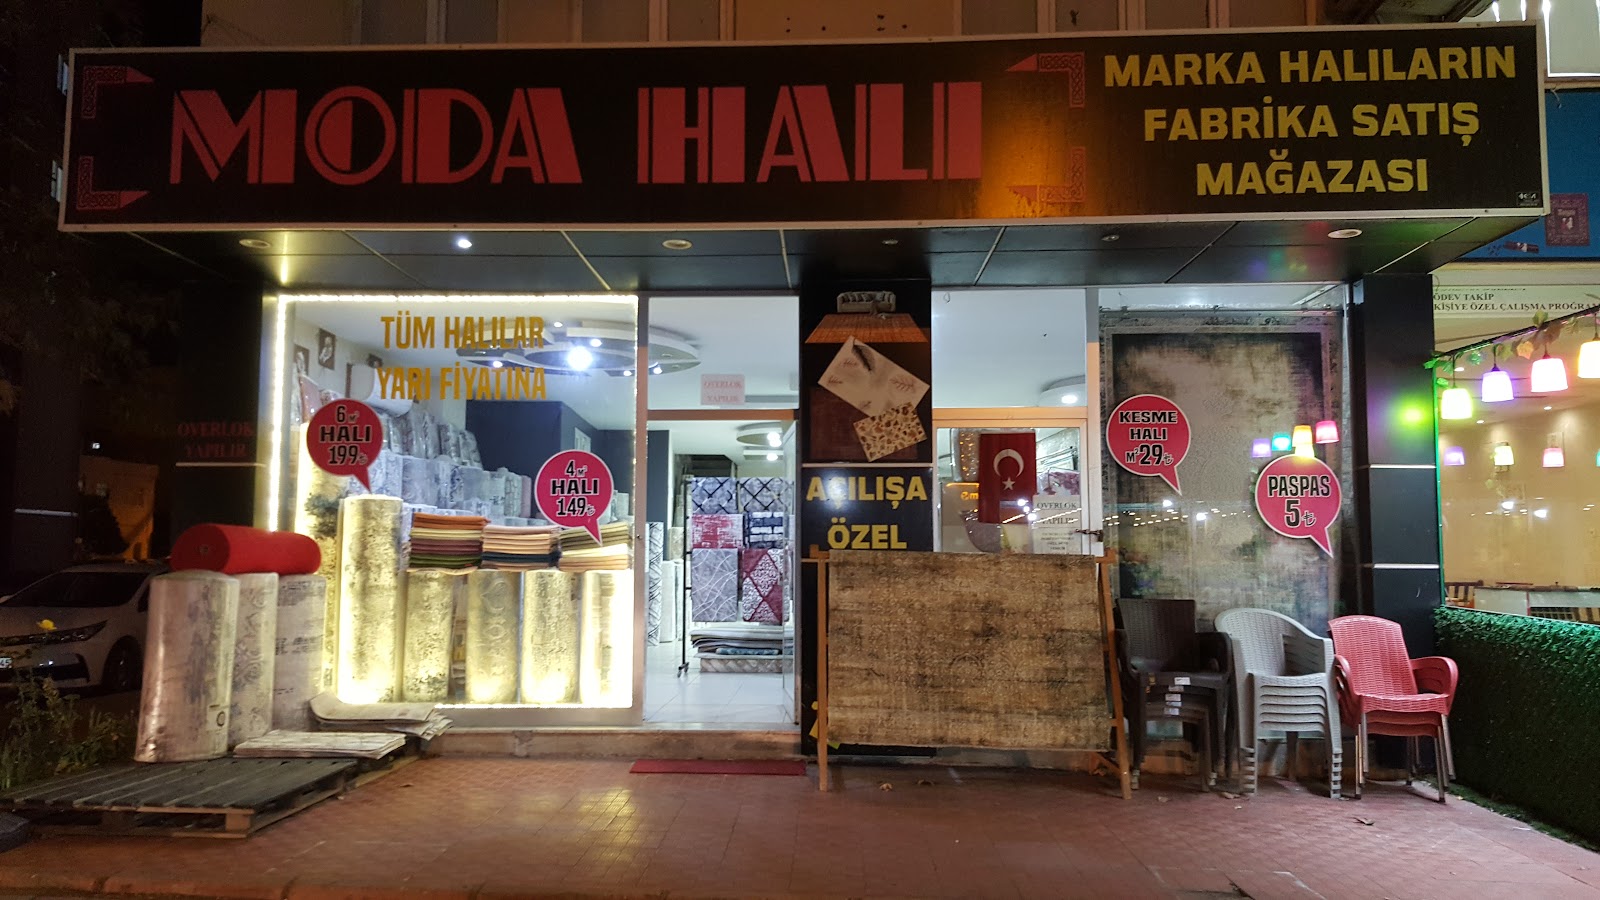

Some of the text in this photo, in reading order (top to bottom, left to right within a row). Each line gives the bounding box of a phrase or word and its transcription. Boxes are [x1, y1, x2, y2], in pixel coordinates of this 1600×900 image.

[1104, 46, 1516, 87] MARKA HALILARIN
[1144, 97, 1479, 147] FABRİKA SATIŞ
[171, 81, 982, 185] MODA HALI
[1196, 149, 1428, 196] MAĞAZASI
[1433, 292, 1494, 300] ÖDEV TAKİP
[1434, 302, 1468, 311] KİŞİYE
[1470, 302, 1498, 310] ÖZEL
[1500, 303, 1546, 312] ÇALIŞMA
[380, 309, 545, 349] TÜM HALILAR
[377, 361, 547, 400] YARI FİYATINA
[336, 405, 347, 423] 6
[1119, 411, 1178, 424] KESME
[319, 425, 372, 443] HALI
[1129, 428, 1168, 441] HALI
[565, 460, 576, 477] 4
[551, 479, 599, 496] HALI
[806, 475, 928, 510] AÇILIŞA
[1267, 475, 1331, 498] PASPAS
[1036, 502, 1077, 510] OVERLOK
[827, 516, 908, 550] ÖZEL
